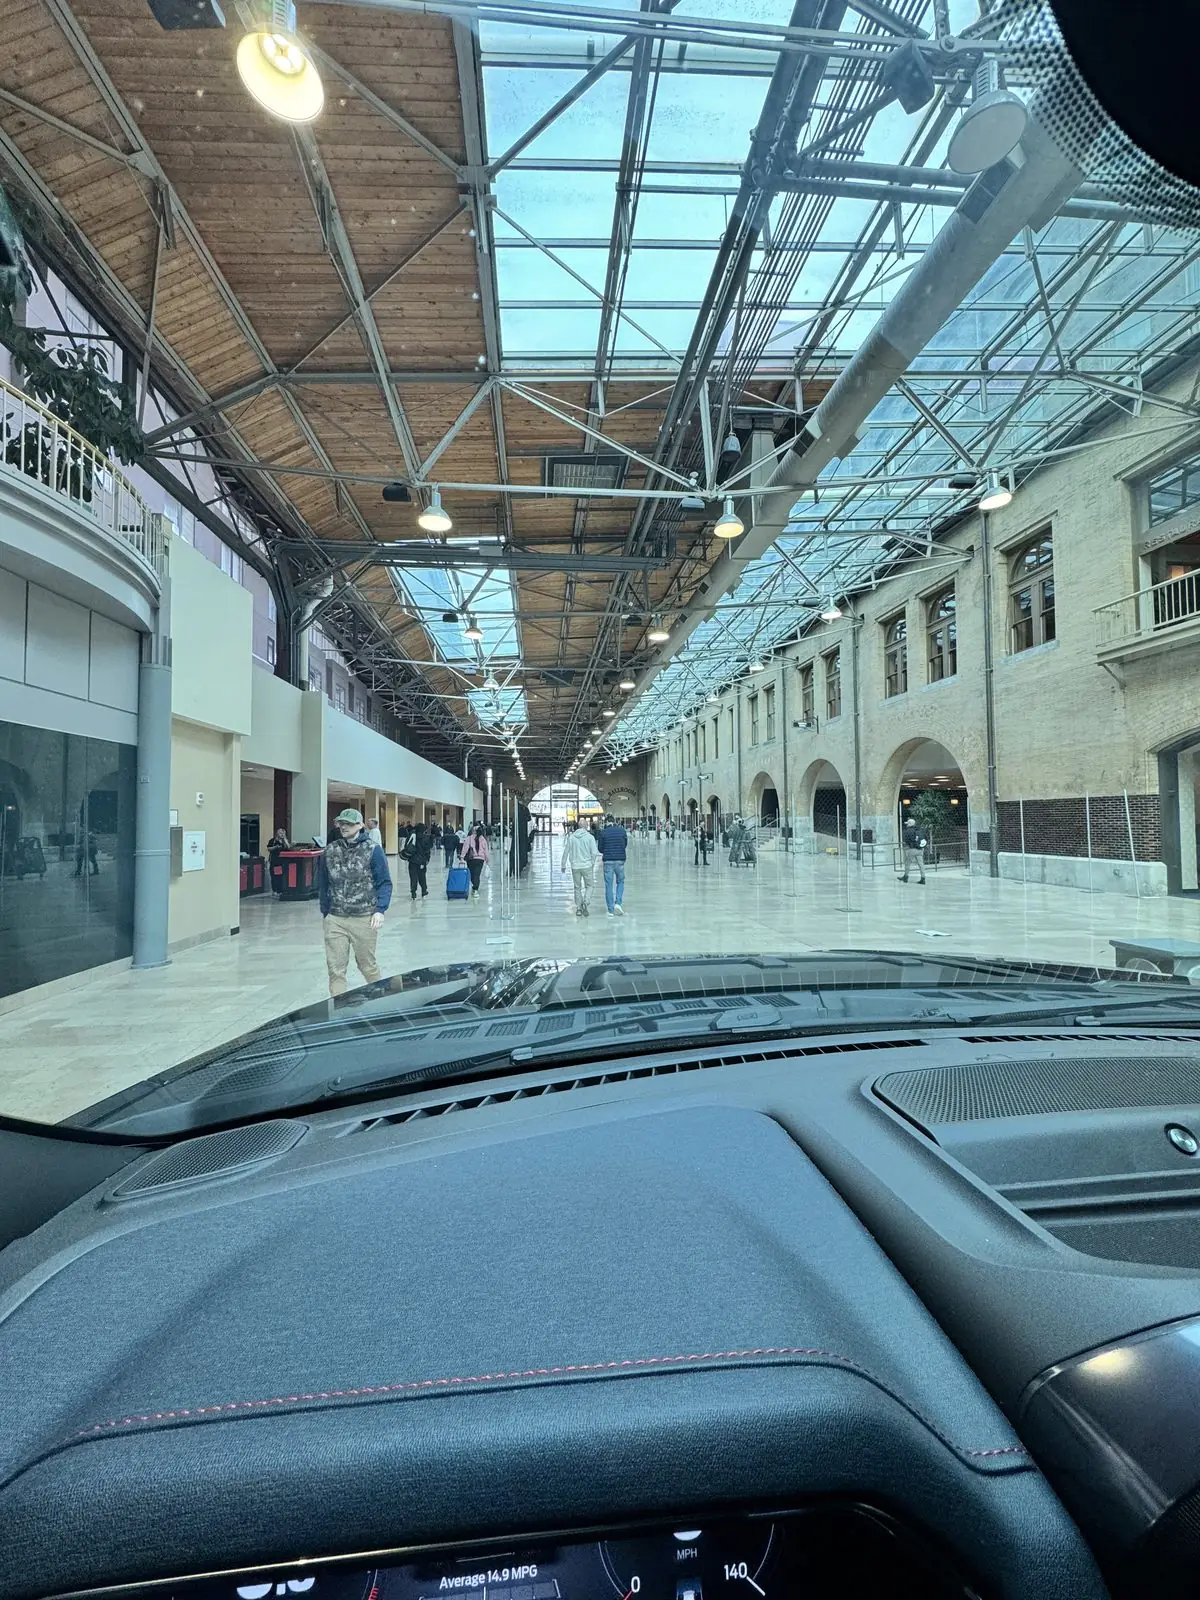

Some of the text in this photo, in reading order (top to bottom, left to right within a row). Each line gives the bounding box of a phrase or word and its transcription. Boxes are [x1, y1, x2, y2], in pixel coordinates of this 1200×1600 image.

[676, 1548, 698, 1560] MPH
[439, 1564, 538, 1590] Average 14.9 MPG
[724, 1562, 748, 1581] 140
[630, 1575, 641, 1593] 0
